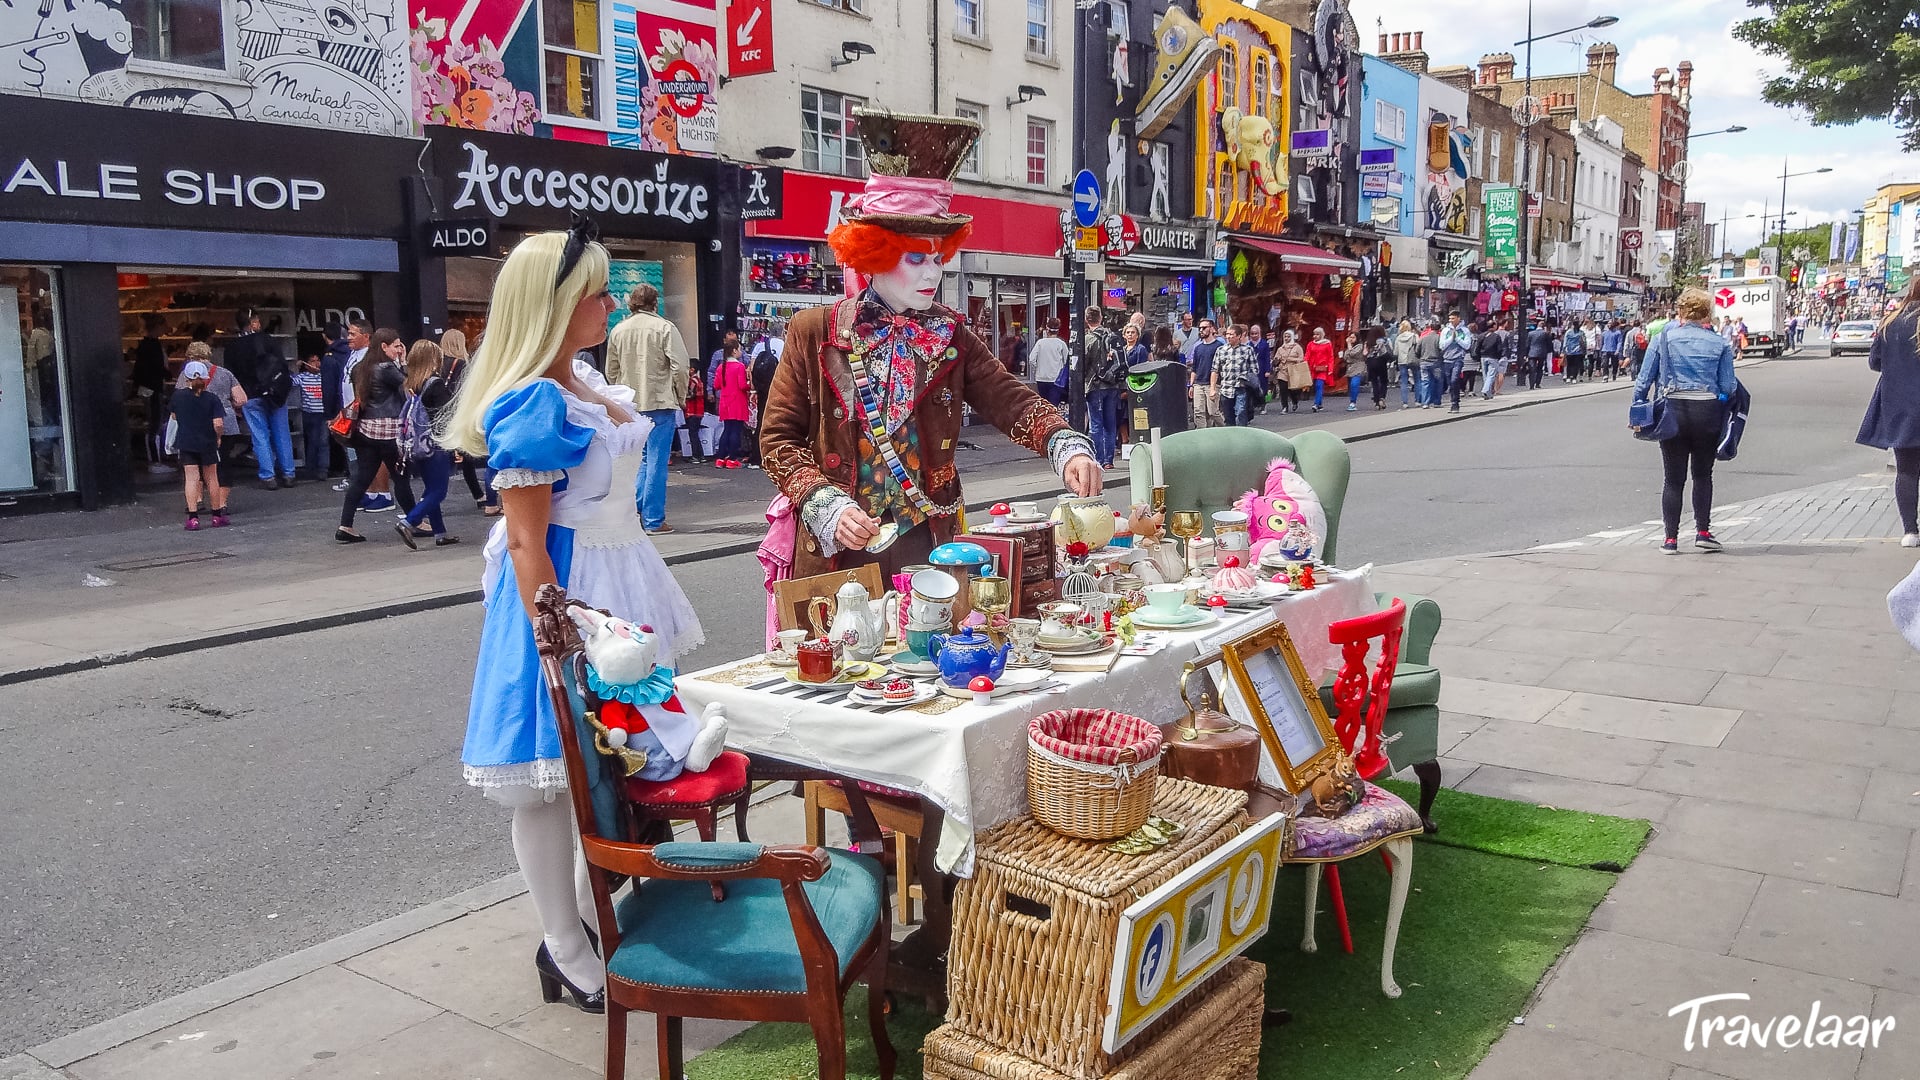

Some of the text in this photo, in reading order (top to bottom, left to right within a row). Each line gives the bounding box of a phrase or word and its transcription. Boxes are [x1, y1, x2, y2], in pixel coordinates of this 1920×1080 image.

[740, 49, 762, 62] KFC
[262, 71, 353, 110] Montreal
[659, 81, 708, 94] UNDERGROUND
[262, 105, 366, 128] Canada 1972
[681, 115, 715, 129] CAMDEN
[681, 128, 703, 140] HIGH
[0, 158, 326, 211] ALE SHOP
[453, 141, 709, 225] Accessorize
[746, 170, 770, 205] A
[1490, 197, 1515, 206] FISH
[741, 206, 776, 219] Accessorize
[433, 229, 487, 248] ALDO
[1143, 227, 1196, 250] QUARTER
[1742, 289, 1770, 305] dpd
